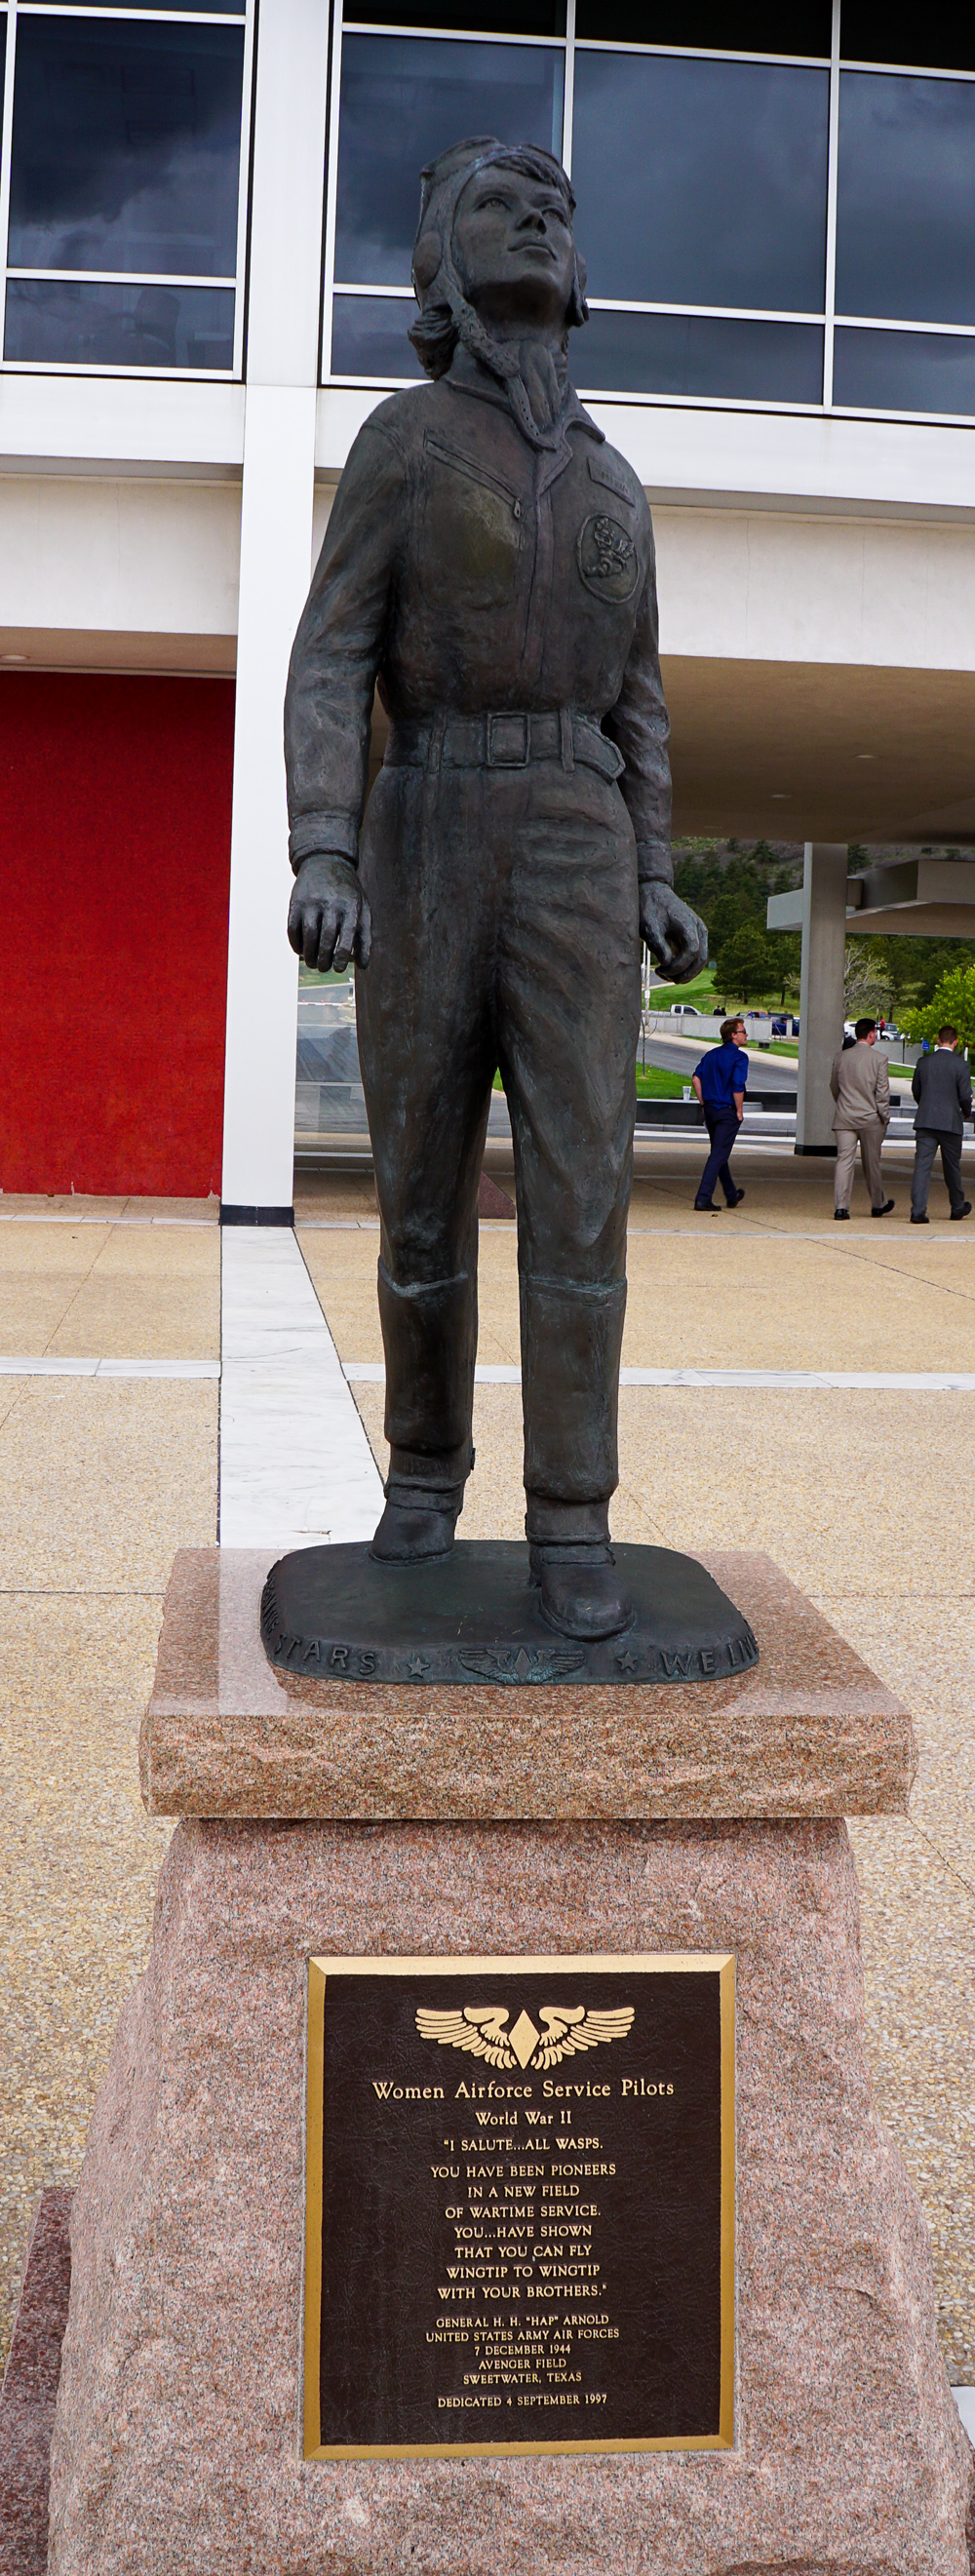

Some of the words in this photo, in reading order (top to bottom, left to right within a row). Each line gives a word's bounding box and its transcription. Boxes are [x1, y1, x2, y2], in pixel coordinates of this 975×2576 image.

[274, 1634, 376, 1675] STARS
[660, 1650, 716, 1677] WE
[371, 2082, 445, 2100] Women
[453, 2080, 532, 2099] Airforce
[542, 2080, 611, 2098] Service
[621, 2078, 675, 2096] Pilots
[475, 2110, 519, 2127] World
[524, 2111, 554, 2126] War
[560, 2110, 572, 2125] II
[555, 2137, 604, 2150] WASPS.
[430, 2166, 460, 2178] YOU
[466, 2166, 504, 2178] HAVE
[510, 2165, 545, 2177] BEEN
[551, 2163, 616, 2176] PIONEERS
[467, 2186, 483, 2199] IN
[488, 2186, 499, 2198] A
[503, 2185, 536, 2198] NEW
[542, 2184, 580, 2197] FIELD
[445, 2206, 464, 2219] OF
[469, 2205, 535, 2219] WARTIME
[540, 2205, 602, 2217] SERVICE.
[540, 2224, 592, 2238] SHOWN
[453, 2246, 493, 2259] THAT
[497, 2245, 527, 2258] YOU
[532, 2244, 564, 2258] CAN
[569, 2244, 593, 2257] FLY
[446, 2266, 508, 2280] WINGTIP
[513, 2265, 533, 2278] TO
[538, 2264, 601, 2278] WINGTIP
[437, 2286, 476, 2300] WITH
[482, 2286, 521, 2299] YOUR
[436, 2317, 489, 2328] GENERAL
[493, 2317, 505, 2327] H.
[509, 2316, 522, 2327] H.
[563, 2314, 609, 2325] ARNOLD
[425, 2331, 469, 2343] UNITED
[473, 2330, 514, 2342] STATES
[517, 2329, 550, 2341] ARMY
[553, 2329, 573, 2340] AIR
[577, 2327, 620, 2339] FORCES
[474, 2346, 481, 2357] 7
[485, 2344, 545, 2356] DECEMBER
[549, 2344, 571, 2355] 1944
[478, 2359, 531, 2370] AVENGER
[535, 2358, 566, 2369] FIELD
[463, 2373, 542, 2385] SWEETWATER,
[546, 2371, 582, 2383] TEXAS
[437, 2397, 502, 2408] DEDICATED
[506, 2397, 513, 2406] 4
[517, 2395, 580, 2406] SEPTEMBER
[585, 2393, 607, 2404] 1997
